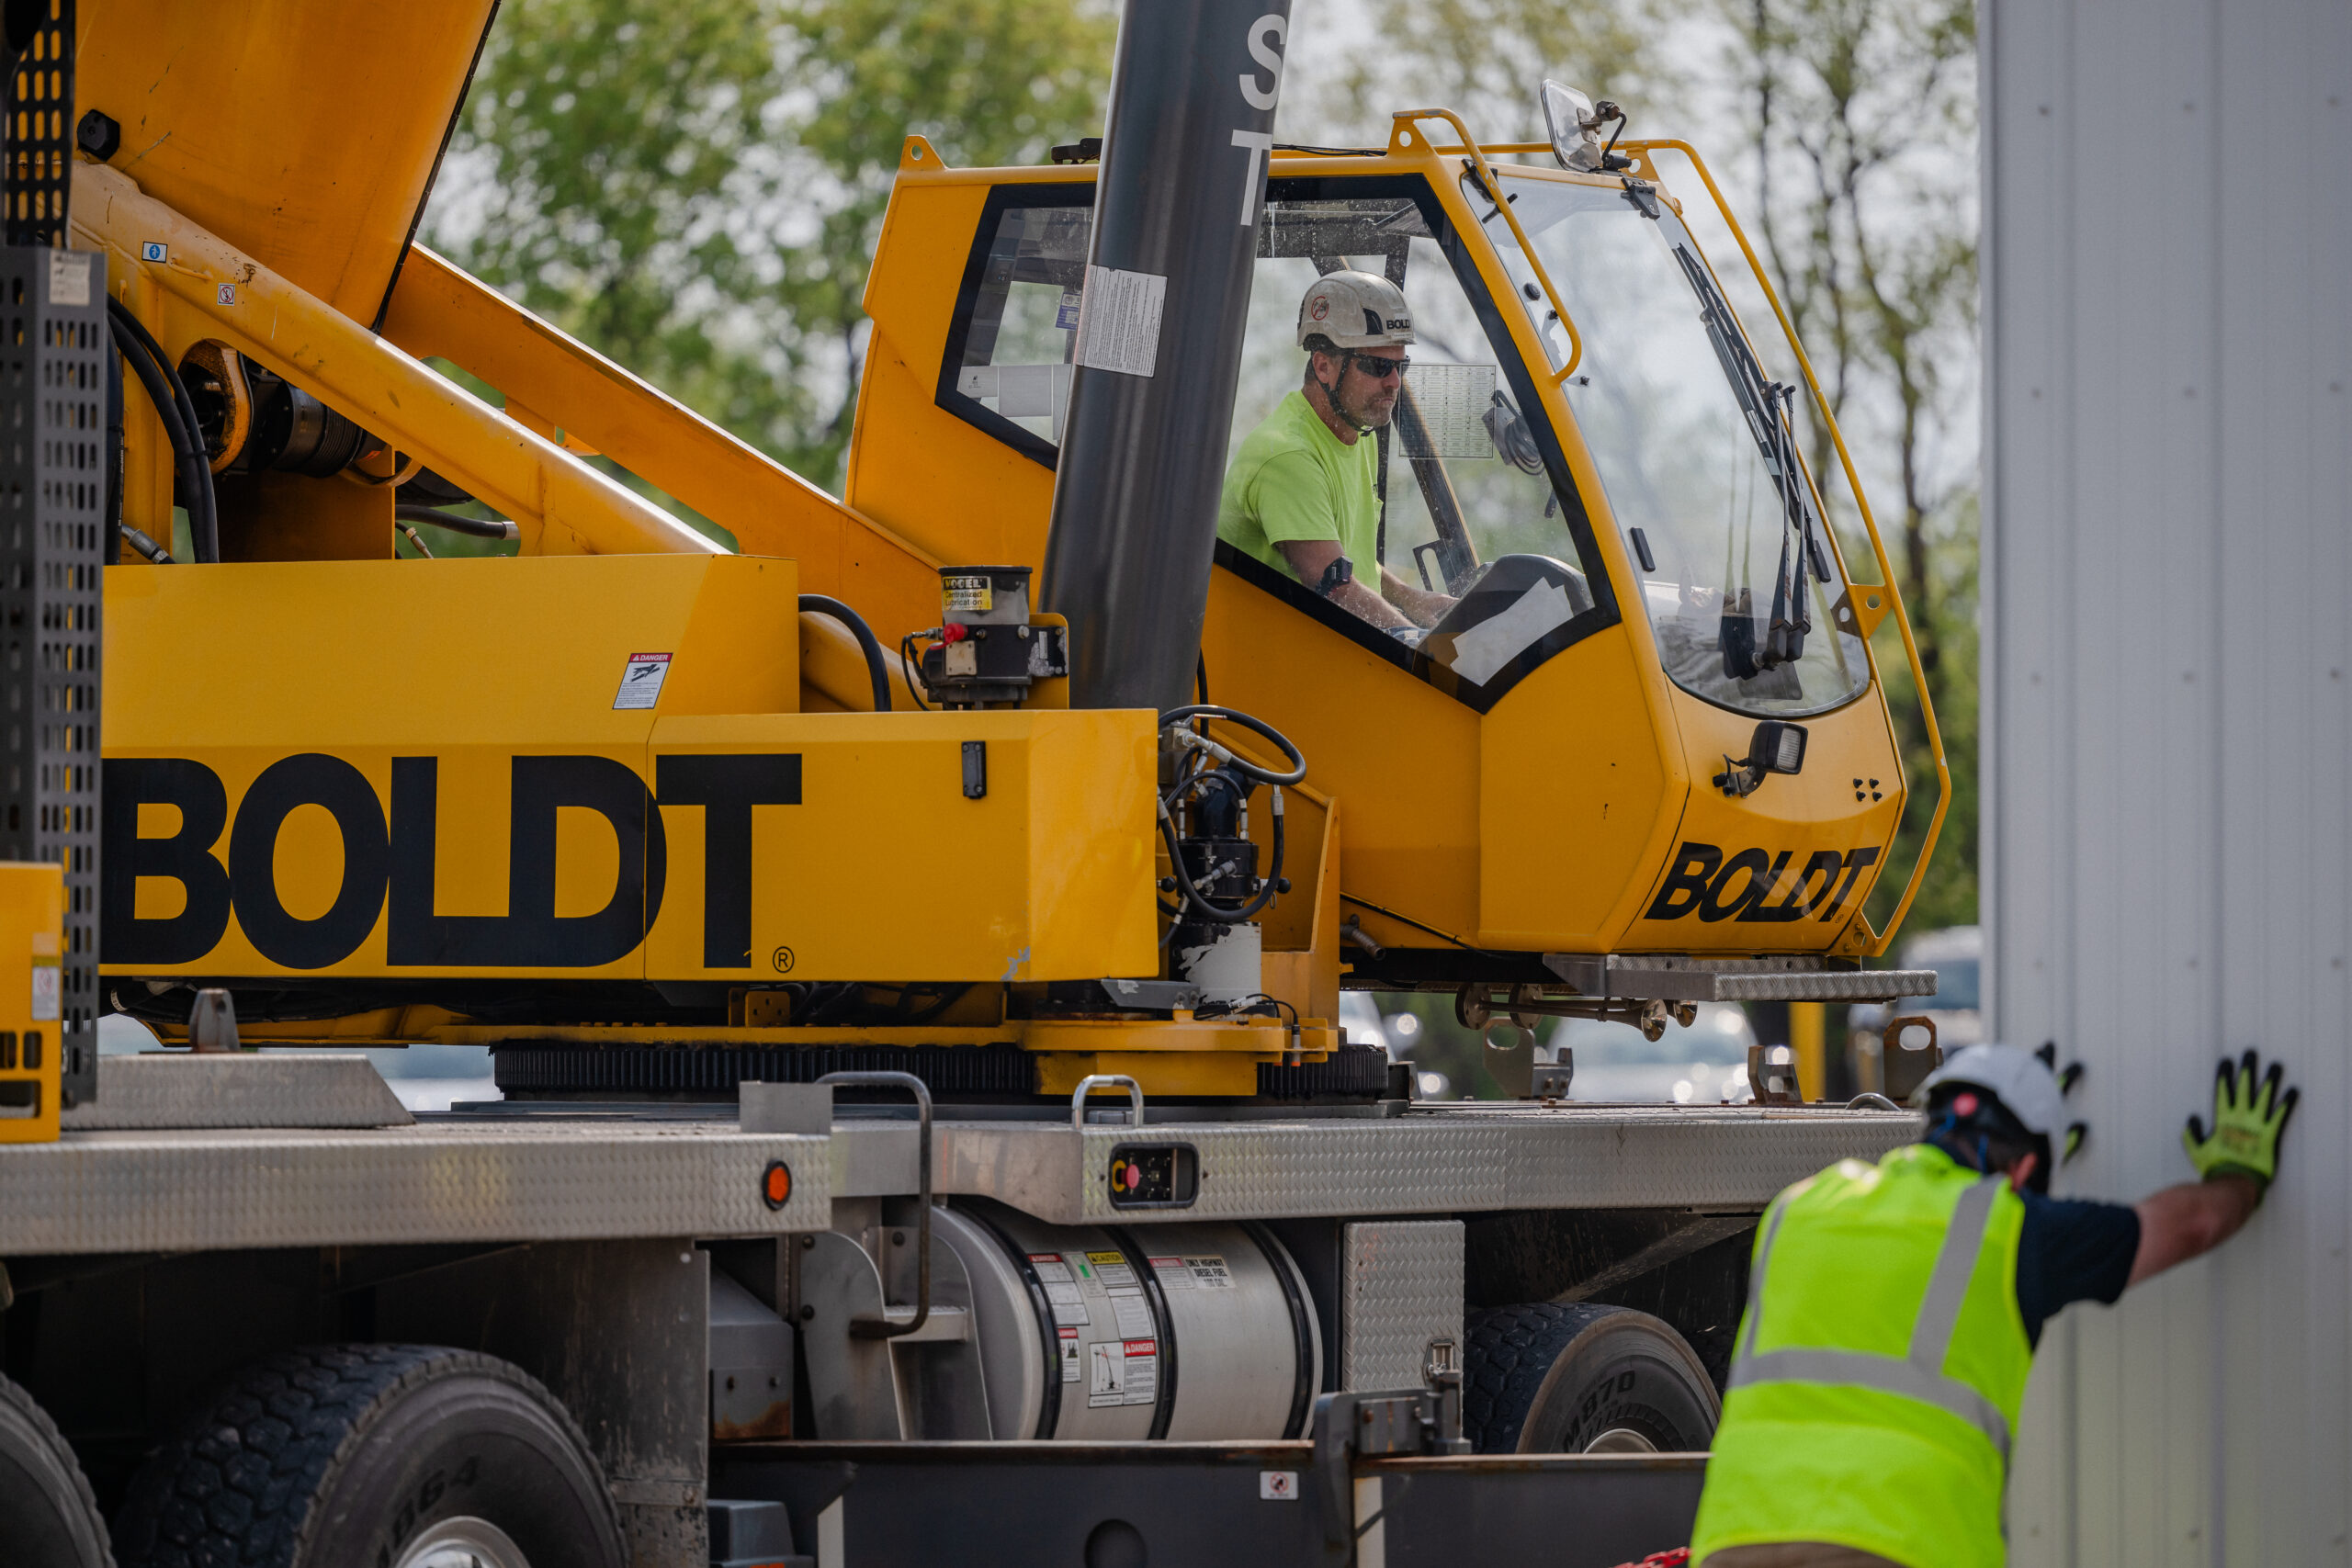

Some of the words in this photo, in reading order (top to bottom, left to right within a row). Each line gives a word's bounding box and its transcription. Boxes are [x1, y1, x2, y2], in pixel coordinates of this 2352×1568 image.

[1231, 14, 1287, 226] ST
[945, 579, 981, 588] VOGEL
[100, 753, 803, 970] BOLDT
[1644, 841, 1882, 923] BOLDT
[1193, 1268, 1214, 1277] DIESEL
[1212, 1268, 1227, 1277] FUEL
[1130, 1342, 1155, 1354] DANGER
